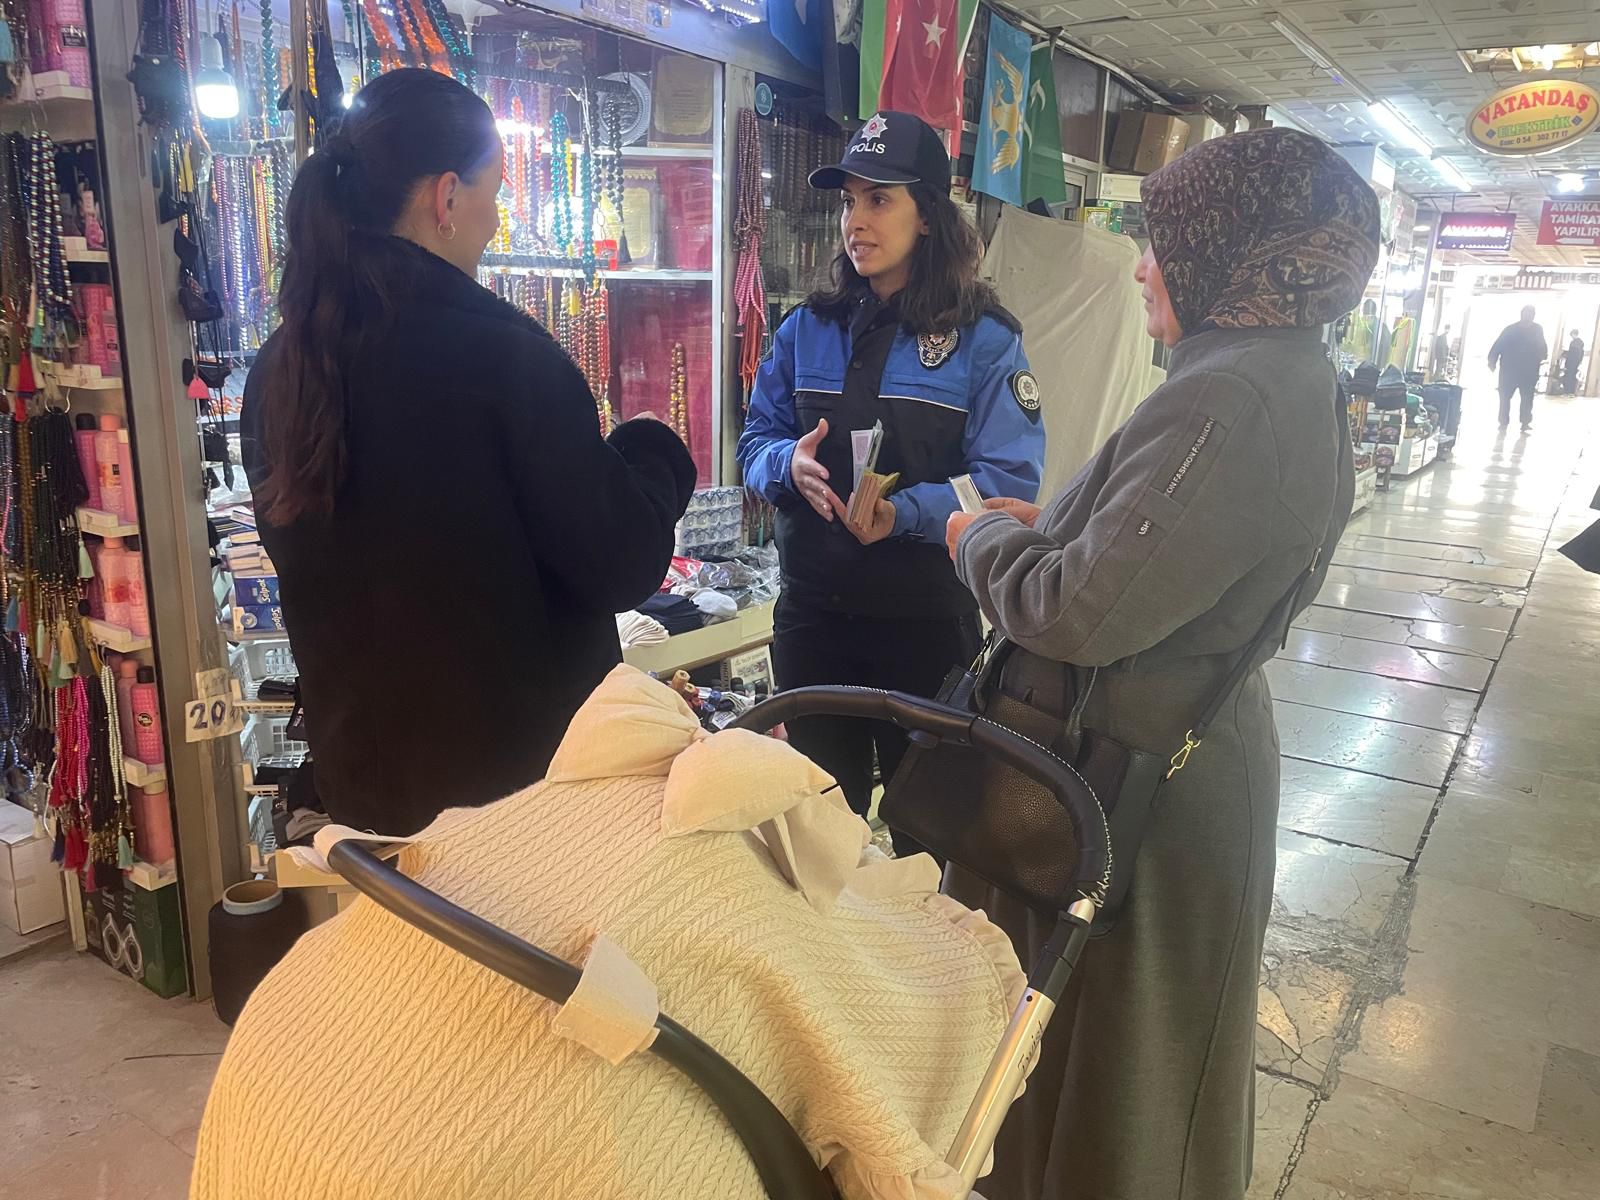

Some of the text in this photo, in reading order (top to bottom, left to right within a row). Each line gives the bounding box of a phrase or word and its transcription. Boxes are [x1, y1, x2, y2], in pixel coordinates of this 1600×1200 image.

[1478, 89, 1590, 125] VATANDAŞ
[1173, 452, 1197, 485] FASHION
[257, 579, 271, 603] Selpak
[190, 700, 226, 729] 20
